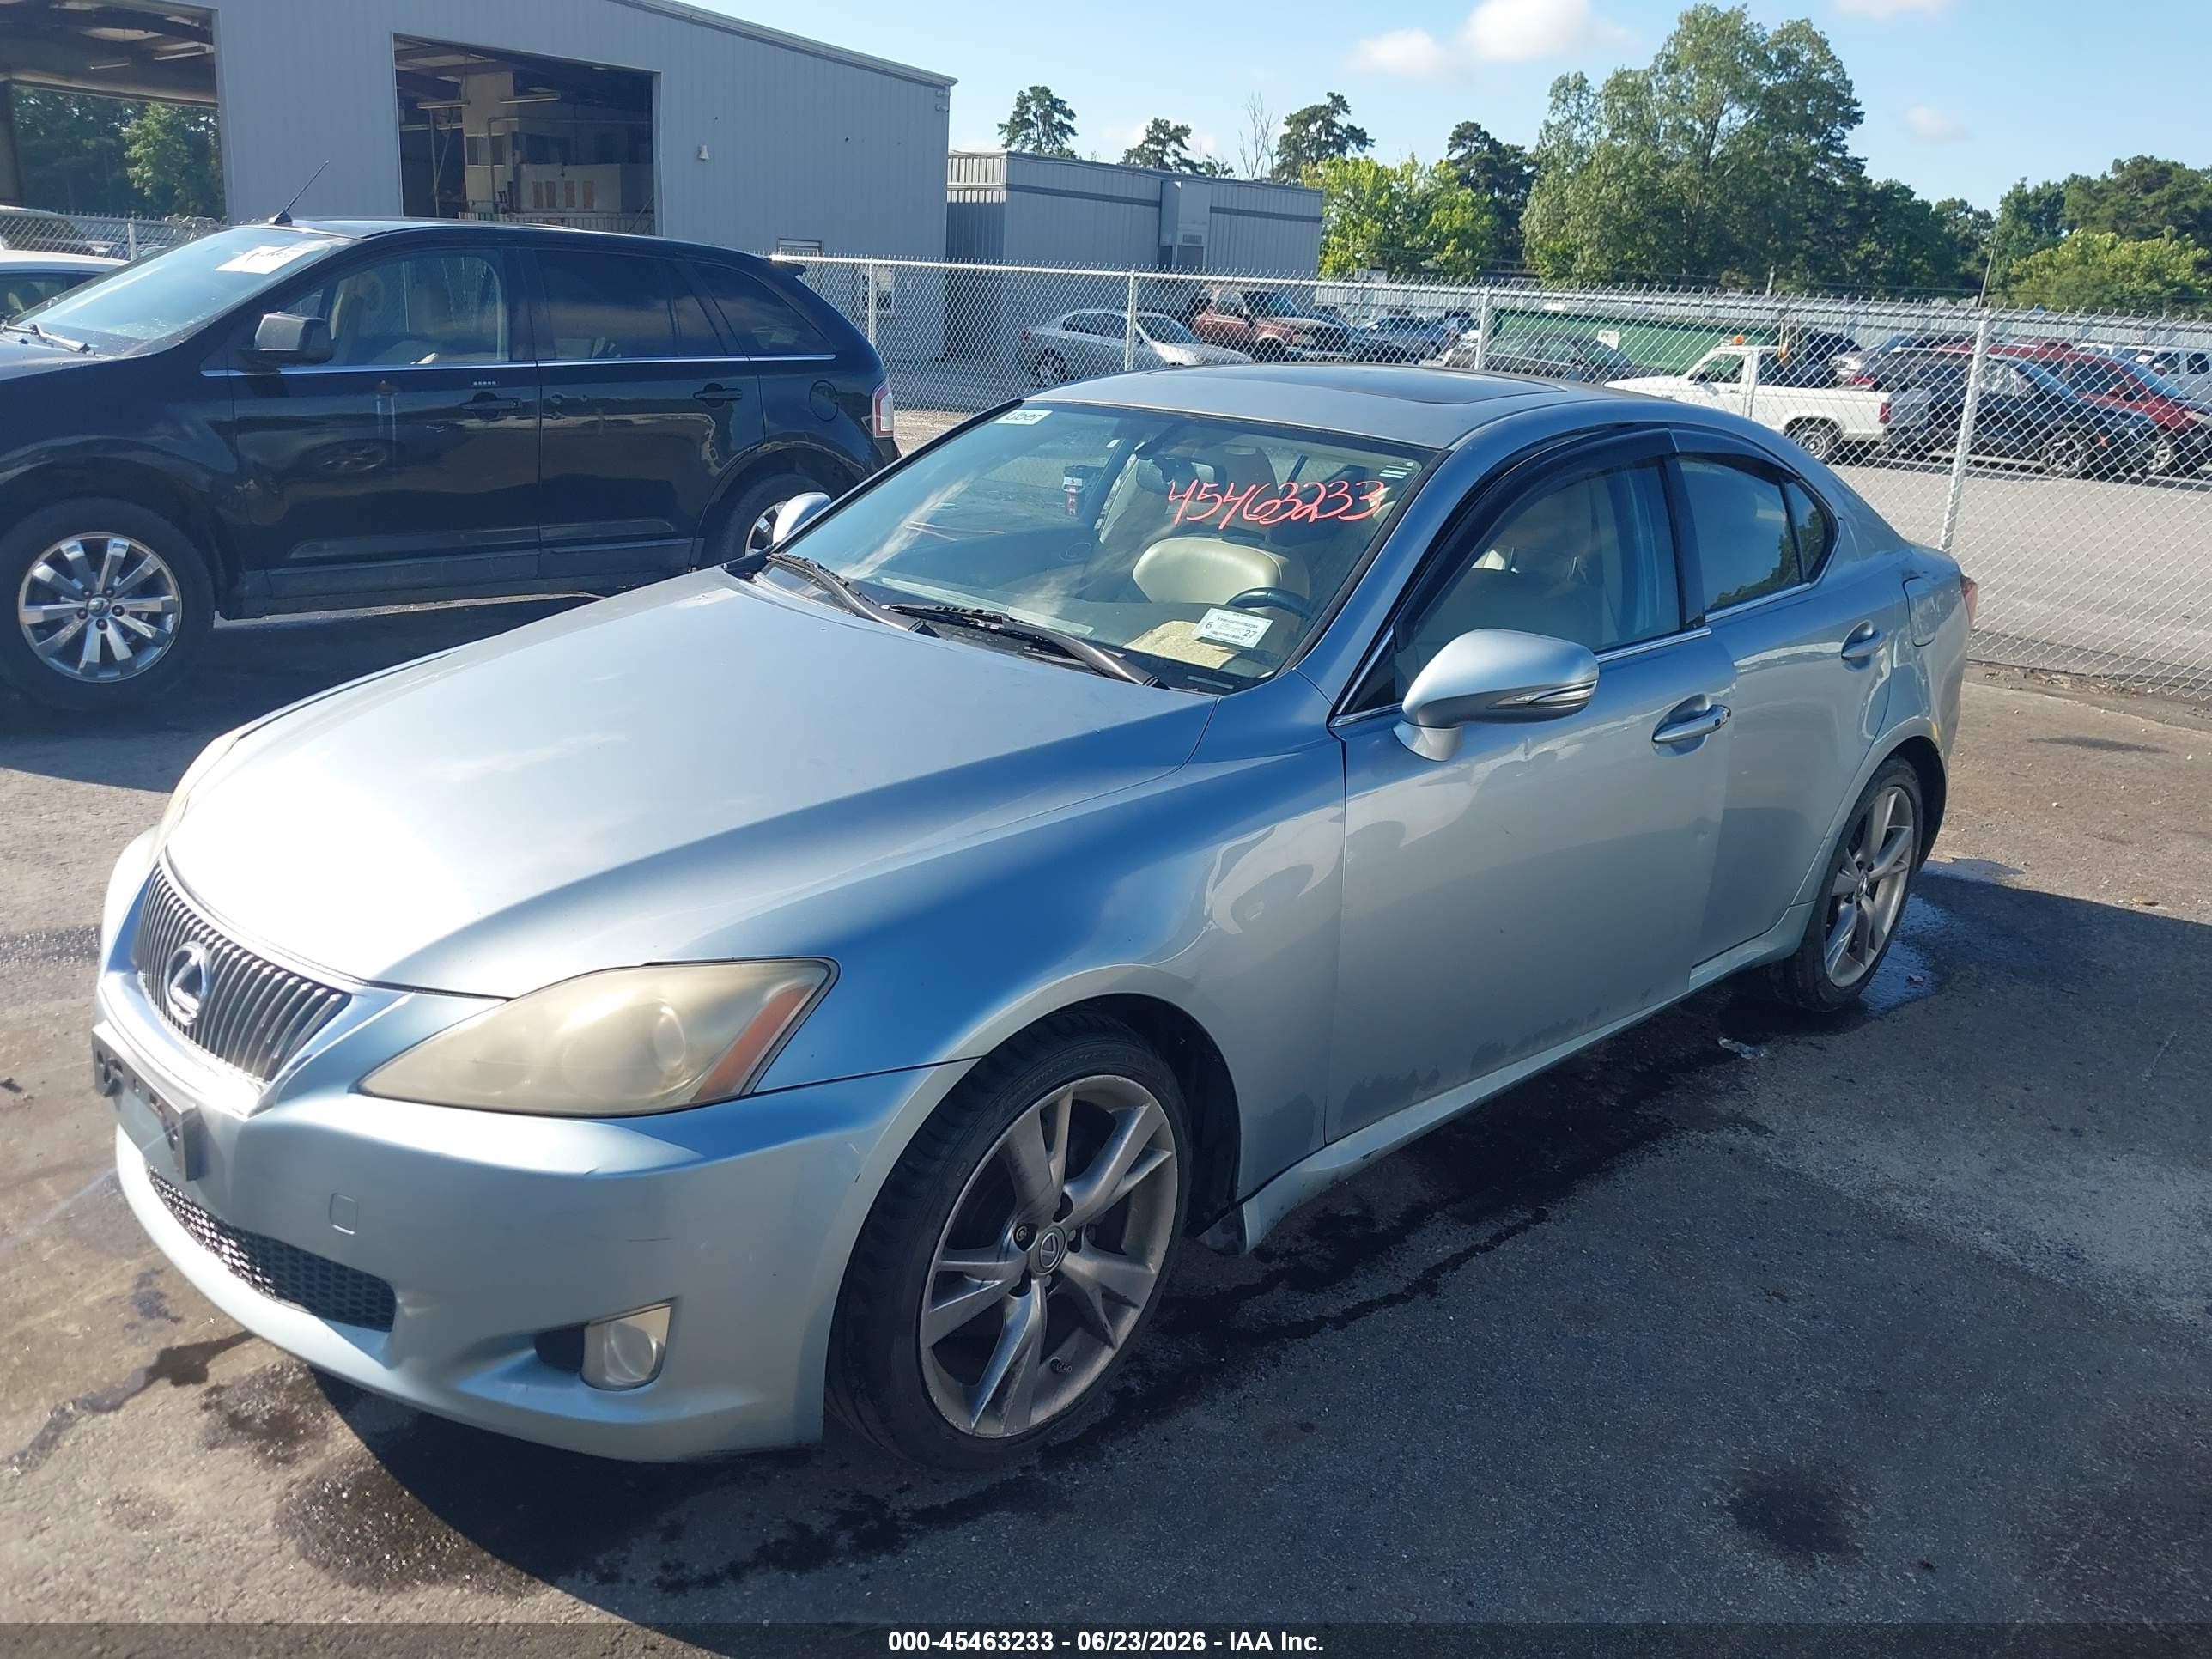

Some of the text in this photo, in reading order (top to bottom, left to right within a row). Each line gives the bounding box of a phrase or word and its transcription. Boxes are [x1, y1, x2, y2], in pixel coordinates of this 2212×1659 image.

[1168, 478, 1386, 530] 45463233
[1206, 621, 1214, 629] 6
[1243, 629, 1258, 639] 27
